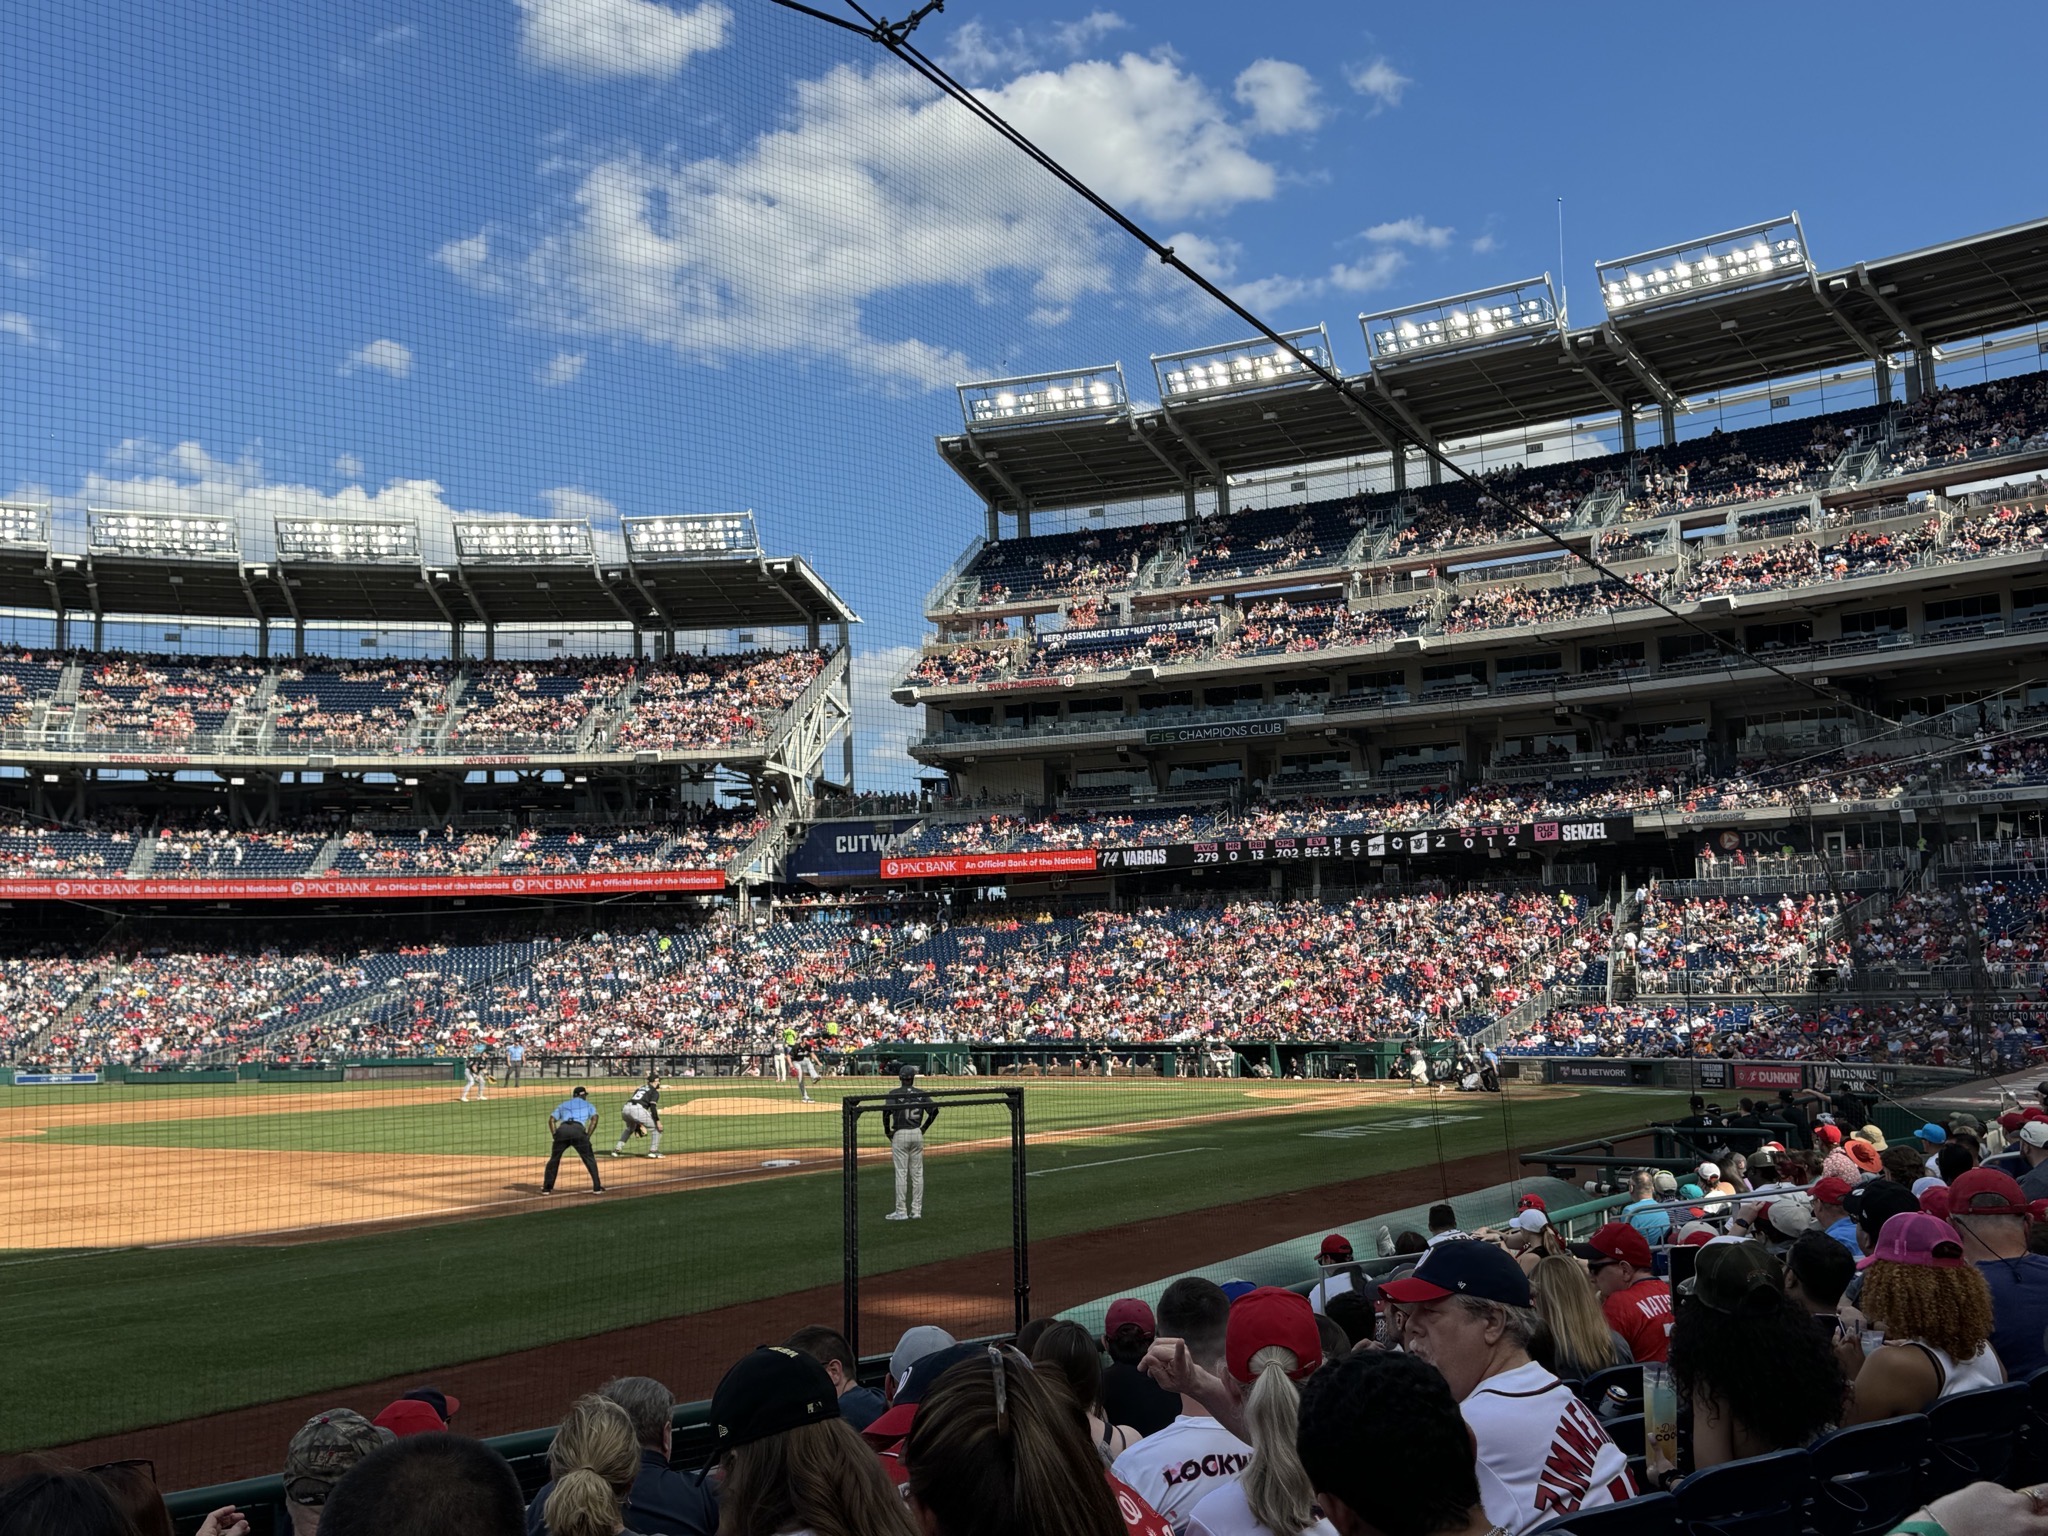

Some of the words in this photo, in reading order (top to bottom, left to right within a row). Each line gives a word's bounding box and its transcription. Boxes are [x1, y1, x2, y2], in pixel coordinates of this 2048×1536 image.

[1063, 629, 1110, 641] ASSISTANCE?
[1111, 628, 1130, 637] TEXT
[1157, 623, 1167, 632] TO
[1178, 725, 1248, 741] CHAMPIONS
[1249, 722, 1282, 735] CLUB
[1969, 792, 2013, 802] GIBSON
[1852, 802, 1879, 811] BELL
[1536, 824, 1556, 832] DUE
[1562, 822, 1607, 841] SENZEL
[1227, 842, 1239, 850] HR
[1250, 841, 1264, 849] RBI
[1276, 839, 1294, 847] OPS
[1435, 834, 1446, 848] 2
[1487, 837, 1493, 847] 1
[1507, 835, 1517, 846] 2
[1742, 829, 1788, 847] PNC
[1122, 848, 1167, 867] VARGAS
[1193, 852, 1219, 863] .279
[1251, 850, 1264, 860] 13
[900, 861, 925, 873] PNC
[925, 860, 957, 872] BANK
[965, 861, 976, 869] An
[977, 859, 1006, 869] Official
[1007, 859, 1027, 867] Bank
[1028, 858, 1038, 866] of
[1039, 858, 1053, 866] the
[1054, 855, 1093, 866] Nationals
[6, 884, 51, 893] Nationals
[71, 883, 102, 895] PNC
[102, 883, 140, 895] BANK
[144, 885, 157, 893] An
[159, 884, 193, 894] Official
[193, 884, 217, 893] Bank
[220, 885, 228, 893] of
[229, 884, 245, 893] the
[246, 884, 288, 893] Nationals
[306, 882, 335, 894] PNC
[335, 882, 370, 893] BANK
[374, 883, 387, 891] An
[420, 882, 442, 891] Bank
[443, 882, 453, 890] of
[454, 881, 469, 890] the
[469, 881, 509, 890] Nationals
[527, 879, 554, 890] PNC
[554, 878, 586, 890] BANK
[590, 879, 601, 887] An
[603, 878, 632, 887] Official
[633, 877, 653, 886] Bank
[654, 876, 663, 885] of
[664, 876, 679, 885] the
[679, 875, 718, 884] Nationals
[2018, 1011, 2028, 1021] TO
[1571, 1068, 1588, 1076] MLB
[1588, 1068, 1627, 1077] NETWORK
[1758, 1071, 1800, 1084] DUNKIN'
[1830, 1068, 1878, 1080] NATIONALS
